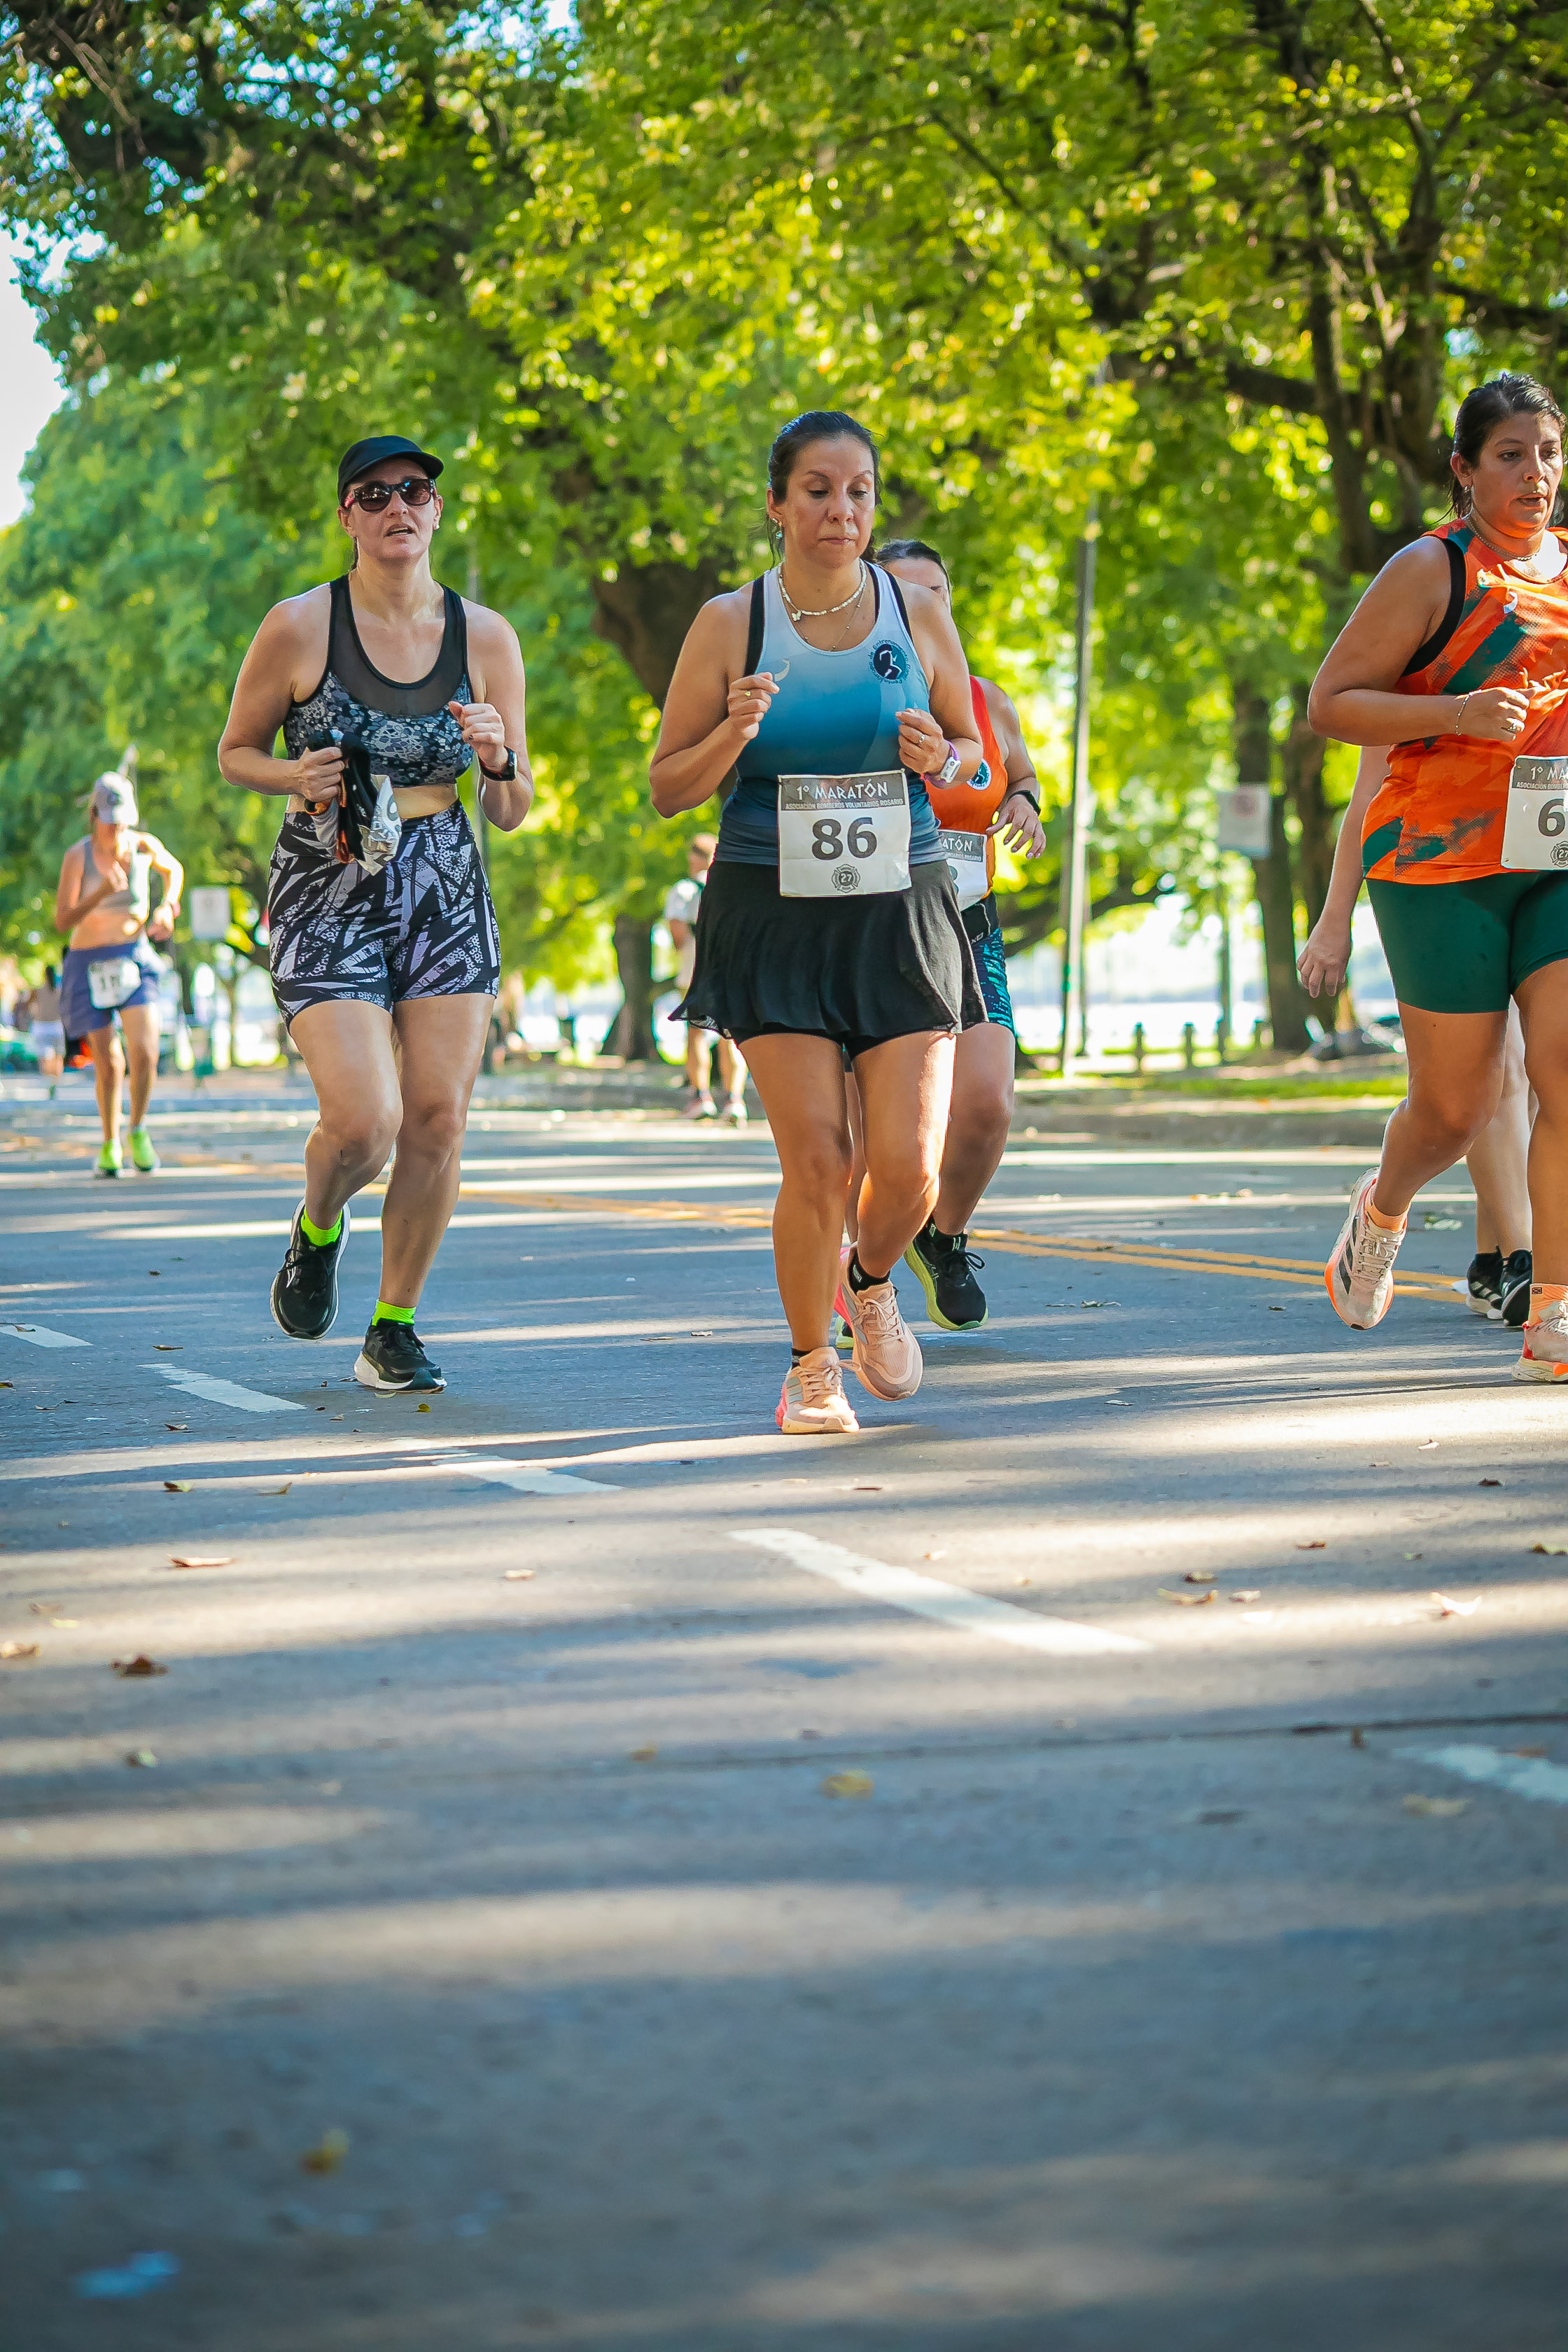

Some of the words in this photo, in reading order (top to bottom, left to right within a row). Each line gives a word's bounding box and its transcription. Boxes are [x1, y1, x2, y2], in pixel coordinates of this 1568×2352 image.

[1546, 766, 1568, 780] MA
[815, 778, 888, 799] MARATÓN
[1516, 781, 1547, 790] ASOCIACIÓN
[845, 800, 879, 808] VOLUNTARIOS
[811, 817, 877, 860] 86
[939, 835, 972, 852] ATÓN
[841, 873, 852, 883] 27
